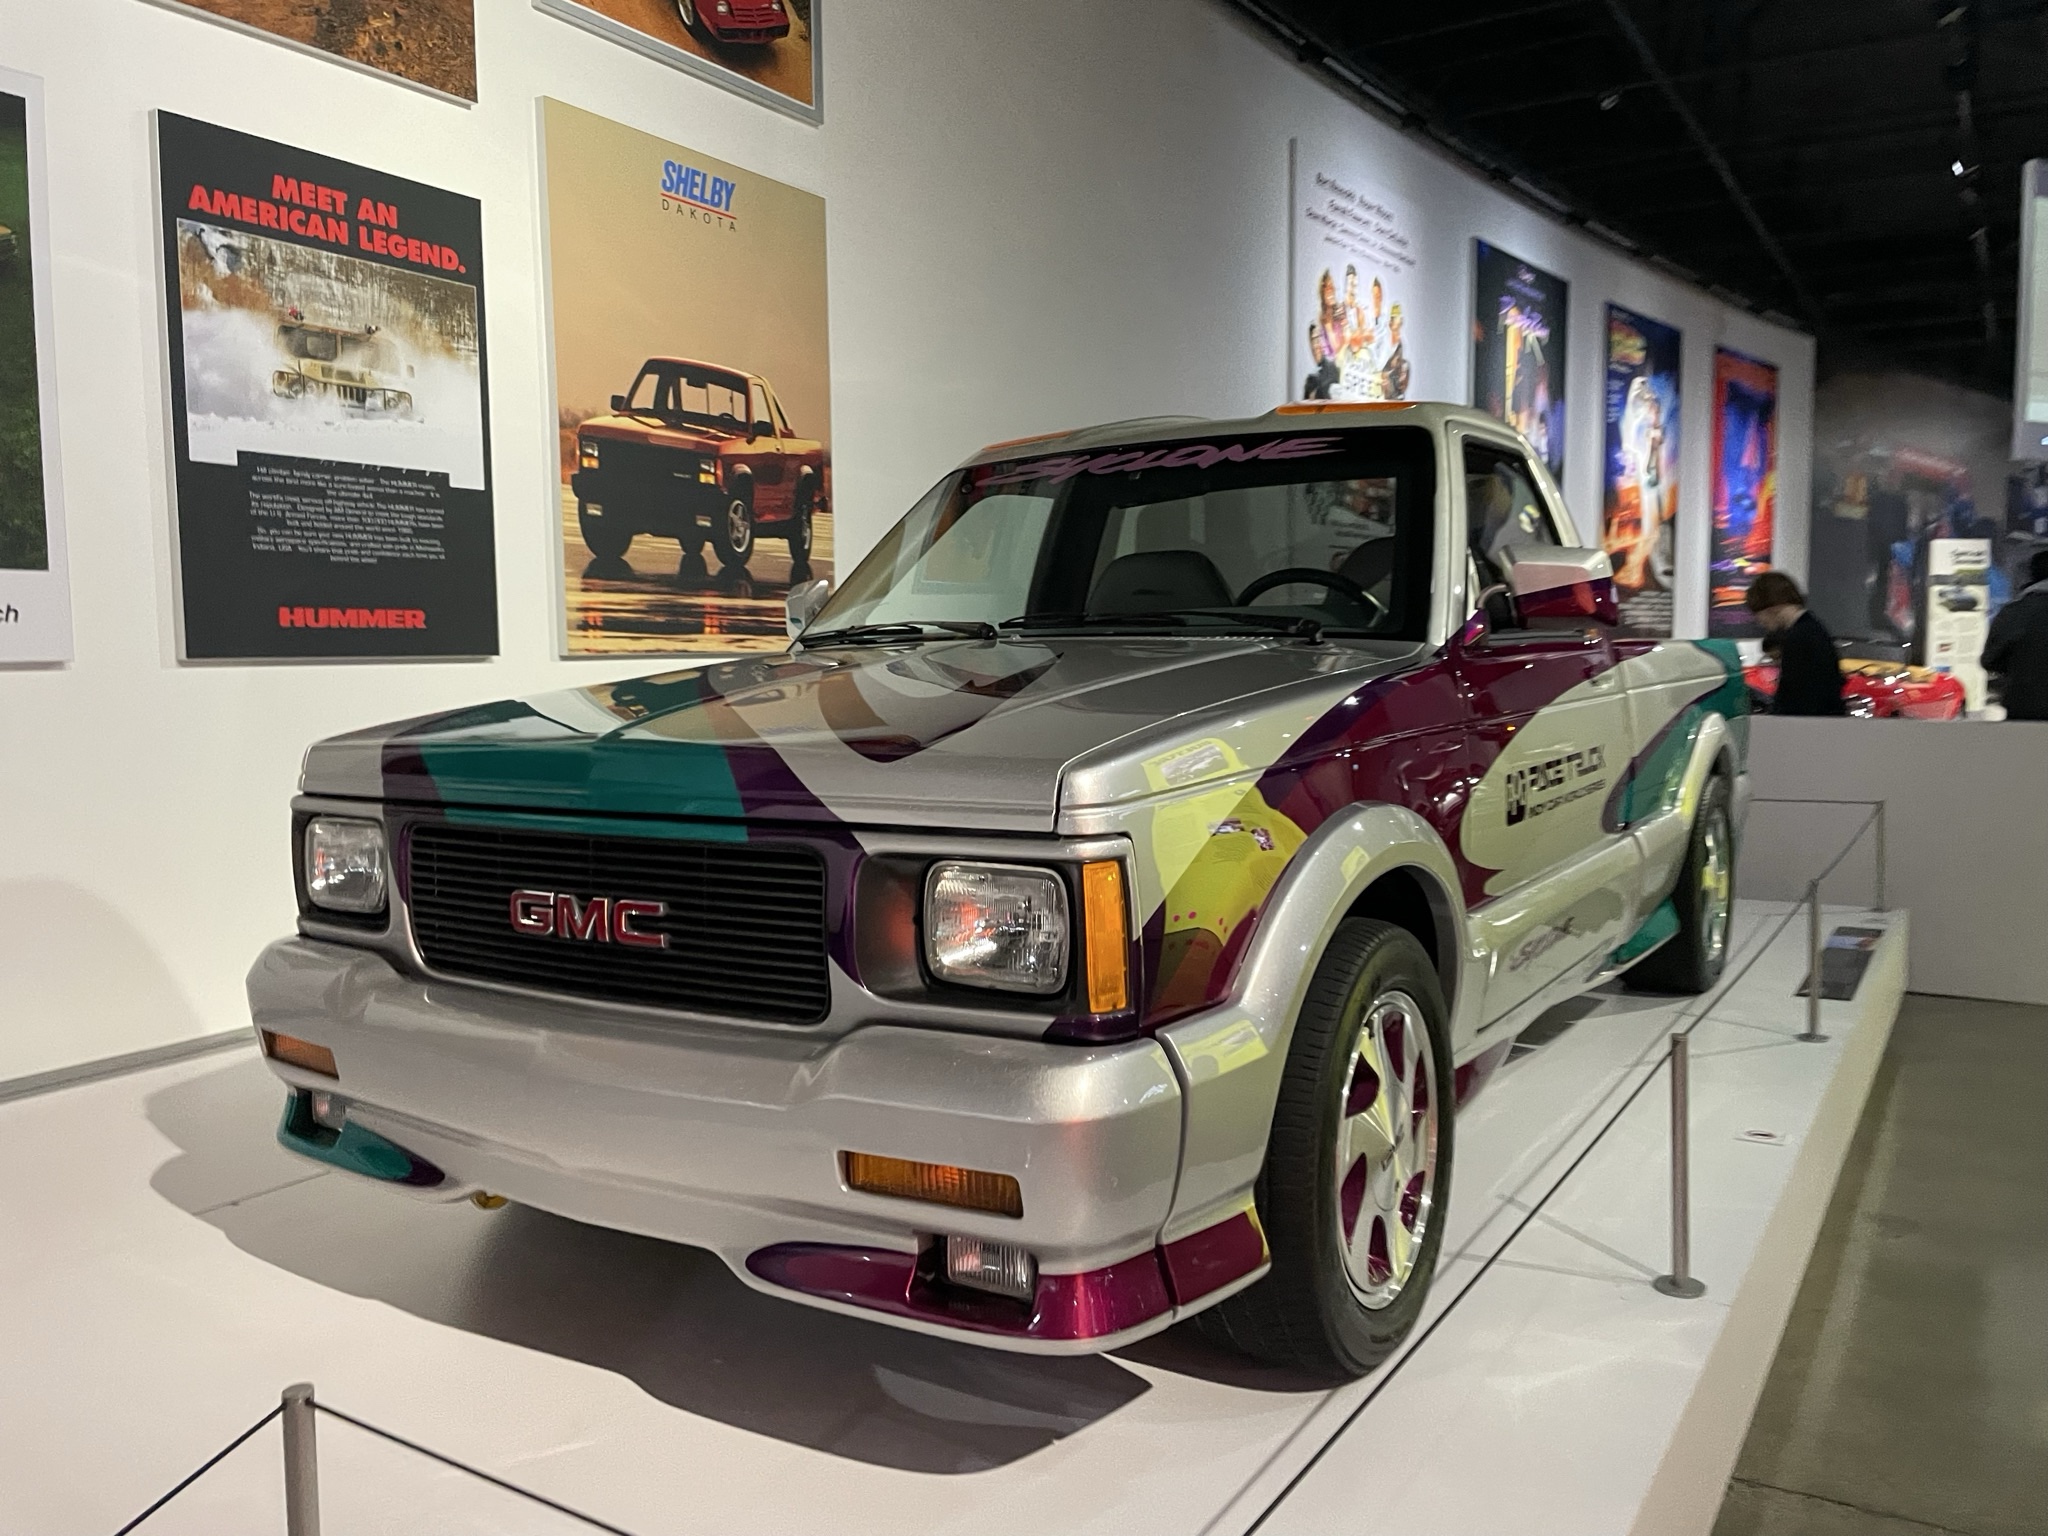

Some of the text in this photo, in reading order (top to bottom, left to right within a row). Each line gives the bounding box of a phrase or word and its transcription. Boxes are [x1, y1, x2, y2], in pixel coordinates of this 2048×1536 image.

[272, 174, 398, 229] MEET AN
[661, 160, 736, 212] SHELBY
[188, 184, 467, 274] AMERICAN LEGEND.
[662, 199, 737, 232] DAKOTA
[975, 437, 1346, 487] SYCLONE
[278, 606, 427, 629] HUMMER
[509, 889, 671, 949] GMC
